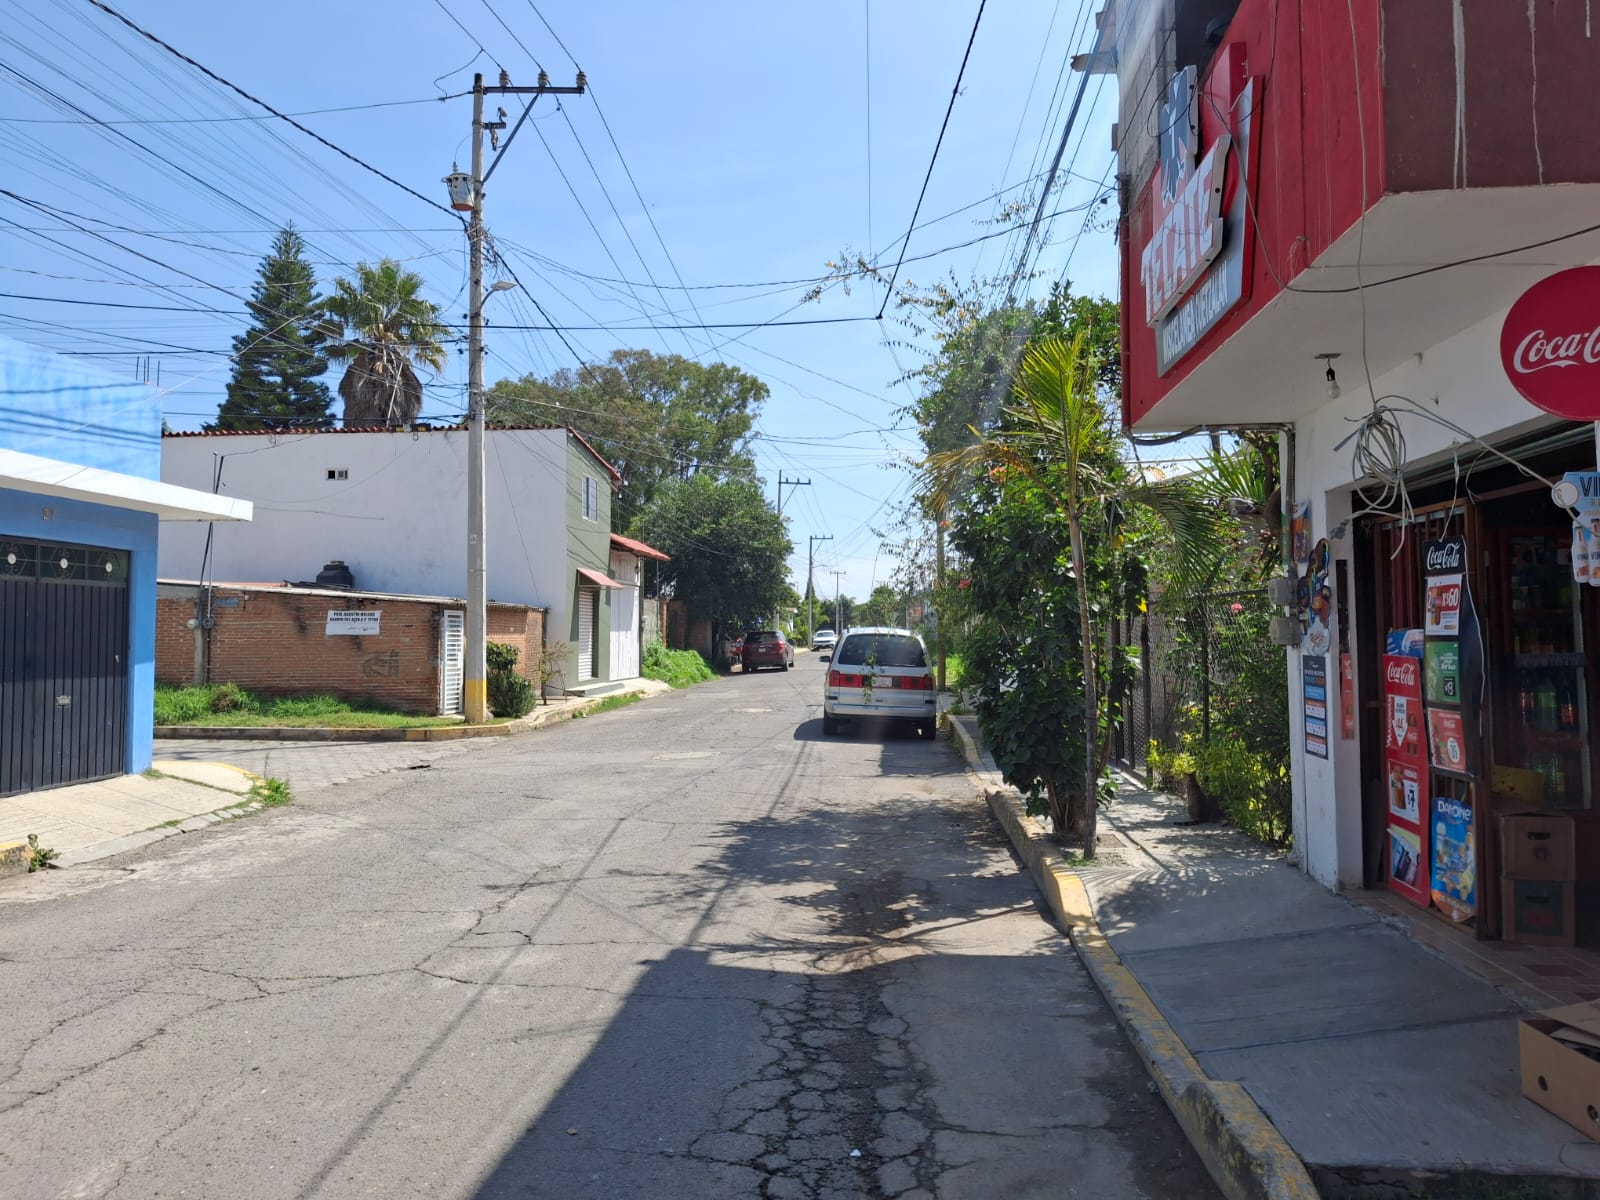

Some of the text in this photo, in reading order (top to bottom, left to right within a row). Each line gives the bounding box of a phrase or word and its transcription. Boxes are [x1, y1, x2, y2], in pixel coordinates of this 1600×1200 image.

[1141, 143, 1215, 324] TECATE
[1427, 542, 1460, 571] Coca-Cola
[1387, 661, 1415, 686] Coca-Cola
